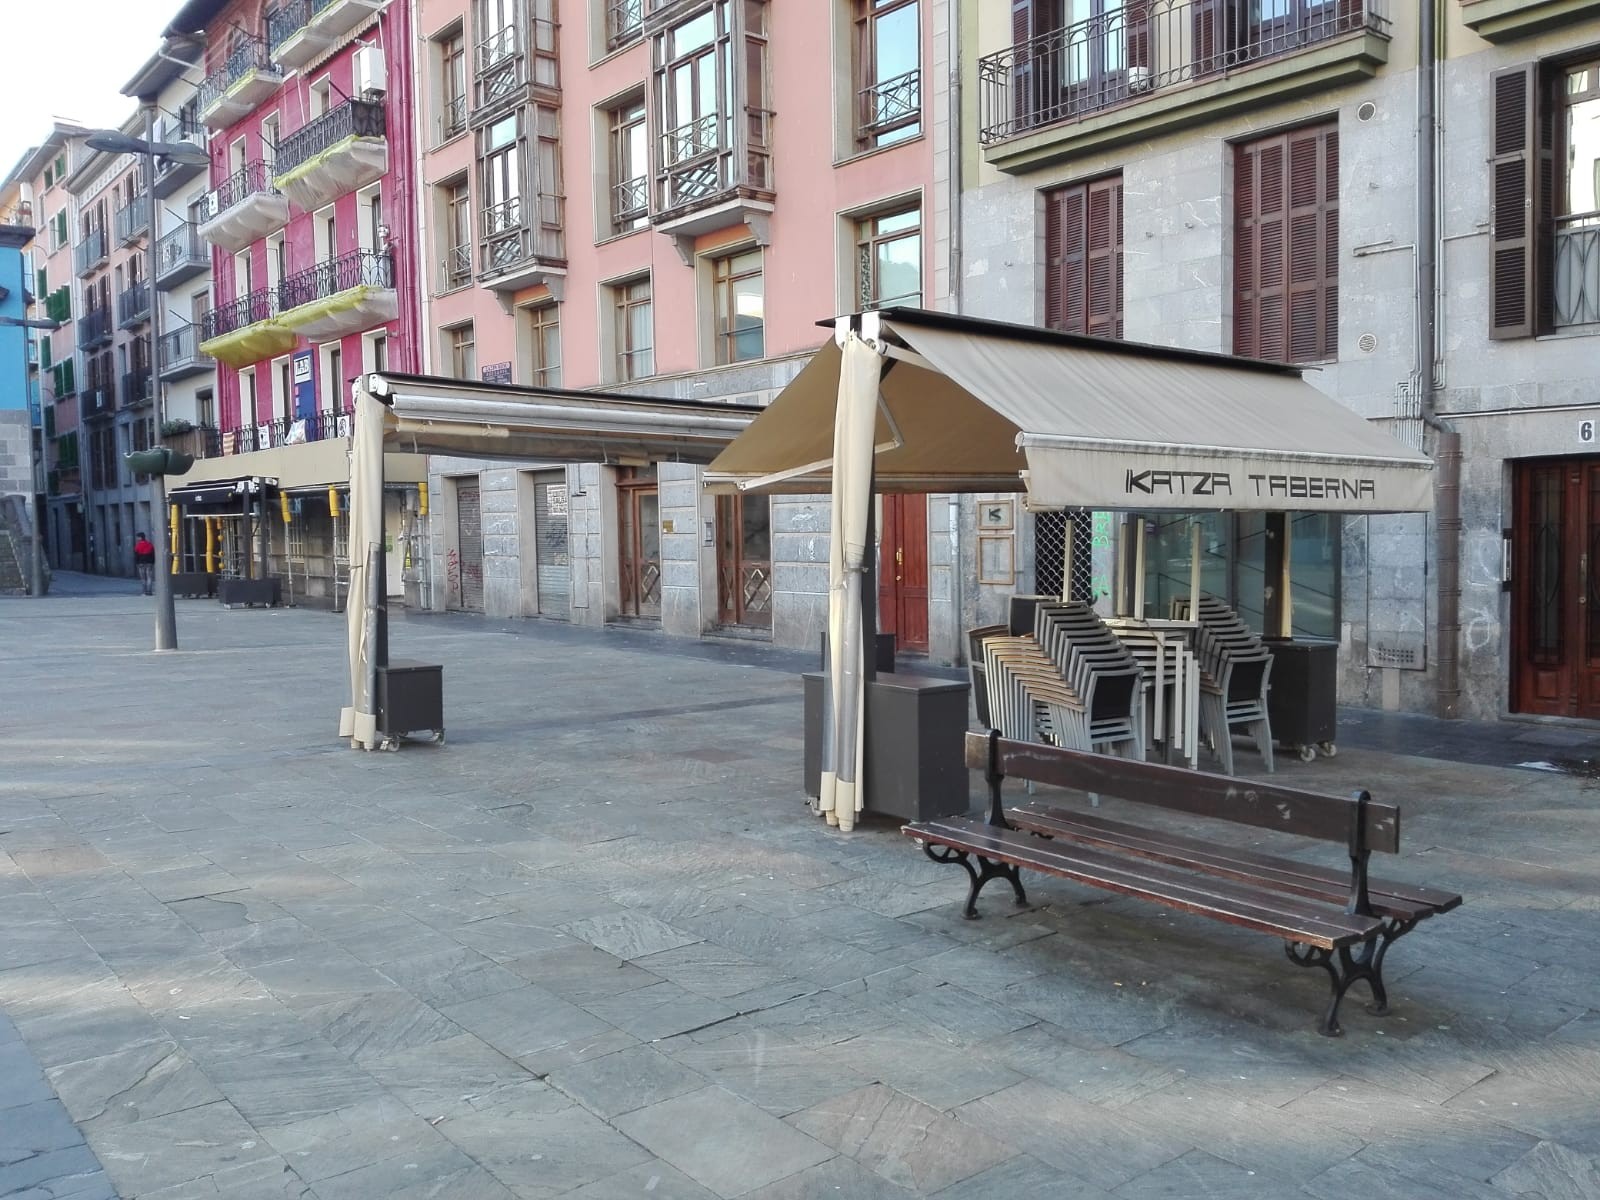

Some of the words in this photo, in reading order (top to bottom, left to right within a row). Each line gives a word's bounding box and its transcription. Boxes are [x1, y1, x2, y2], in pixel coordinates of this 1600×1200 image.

[1580, 421, 1592, 441] 6
[1125, 469, 1232, 495] KATZA
[1248, 474, 1375, 500] TABERNA
